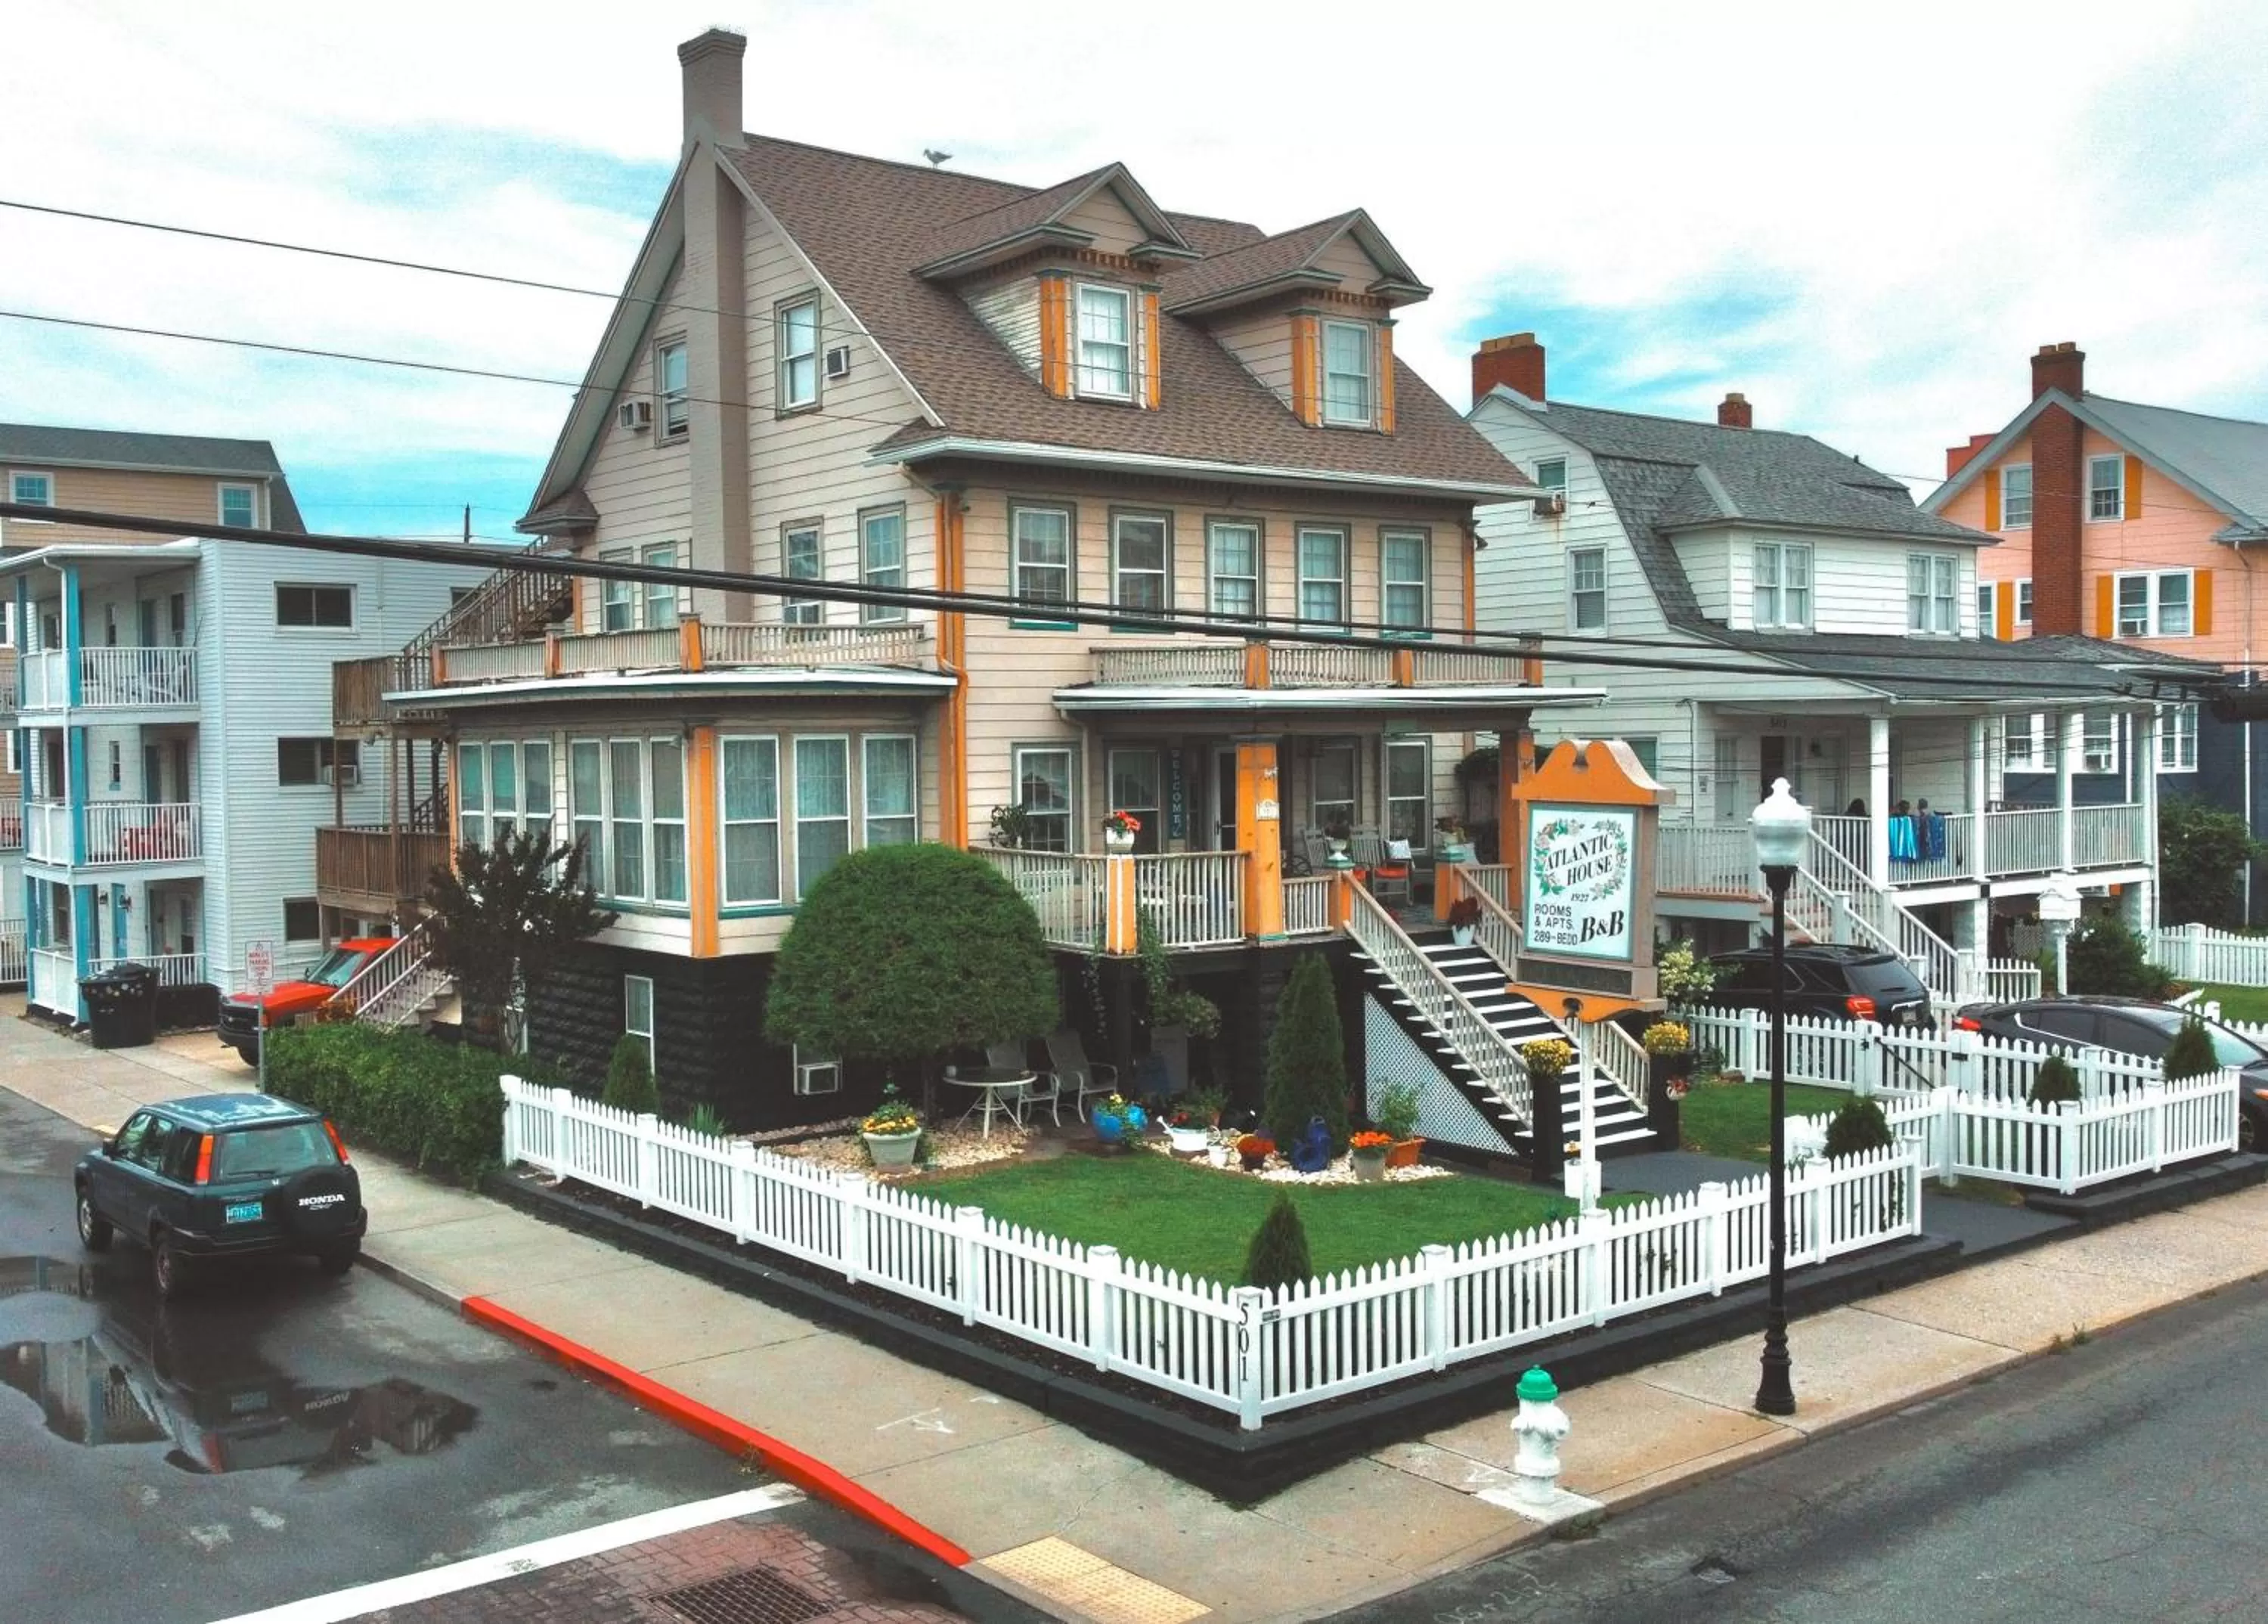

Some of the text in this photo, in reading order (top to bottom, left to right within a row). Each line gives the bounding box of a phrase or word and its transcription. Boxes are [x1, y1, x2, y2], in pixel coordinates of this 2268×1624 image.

[1545, 834, 1613, 872] ATLANTIC
[1567, 854, 1613, 886] HOUSE
[1534, 903, 1572, 917] ROOMS
[1534, 916, 1541, 926] &
[1579, 910, 1624, 943] B&B
[299, 1194, 345, 1206] HONDA
